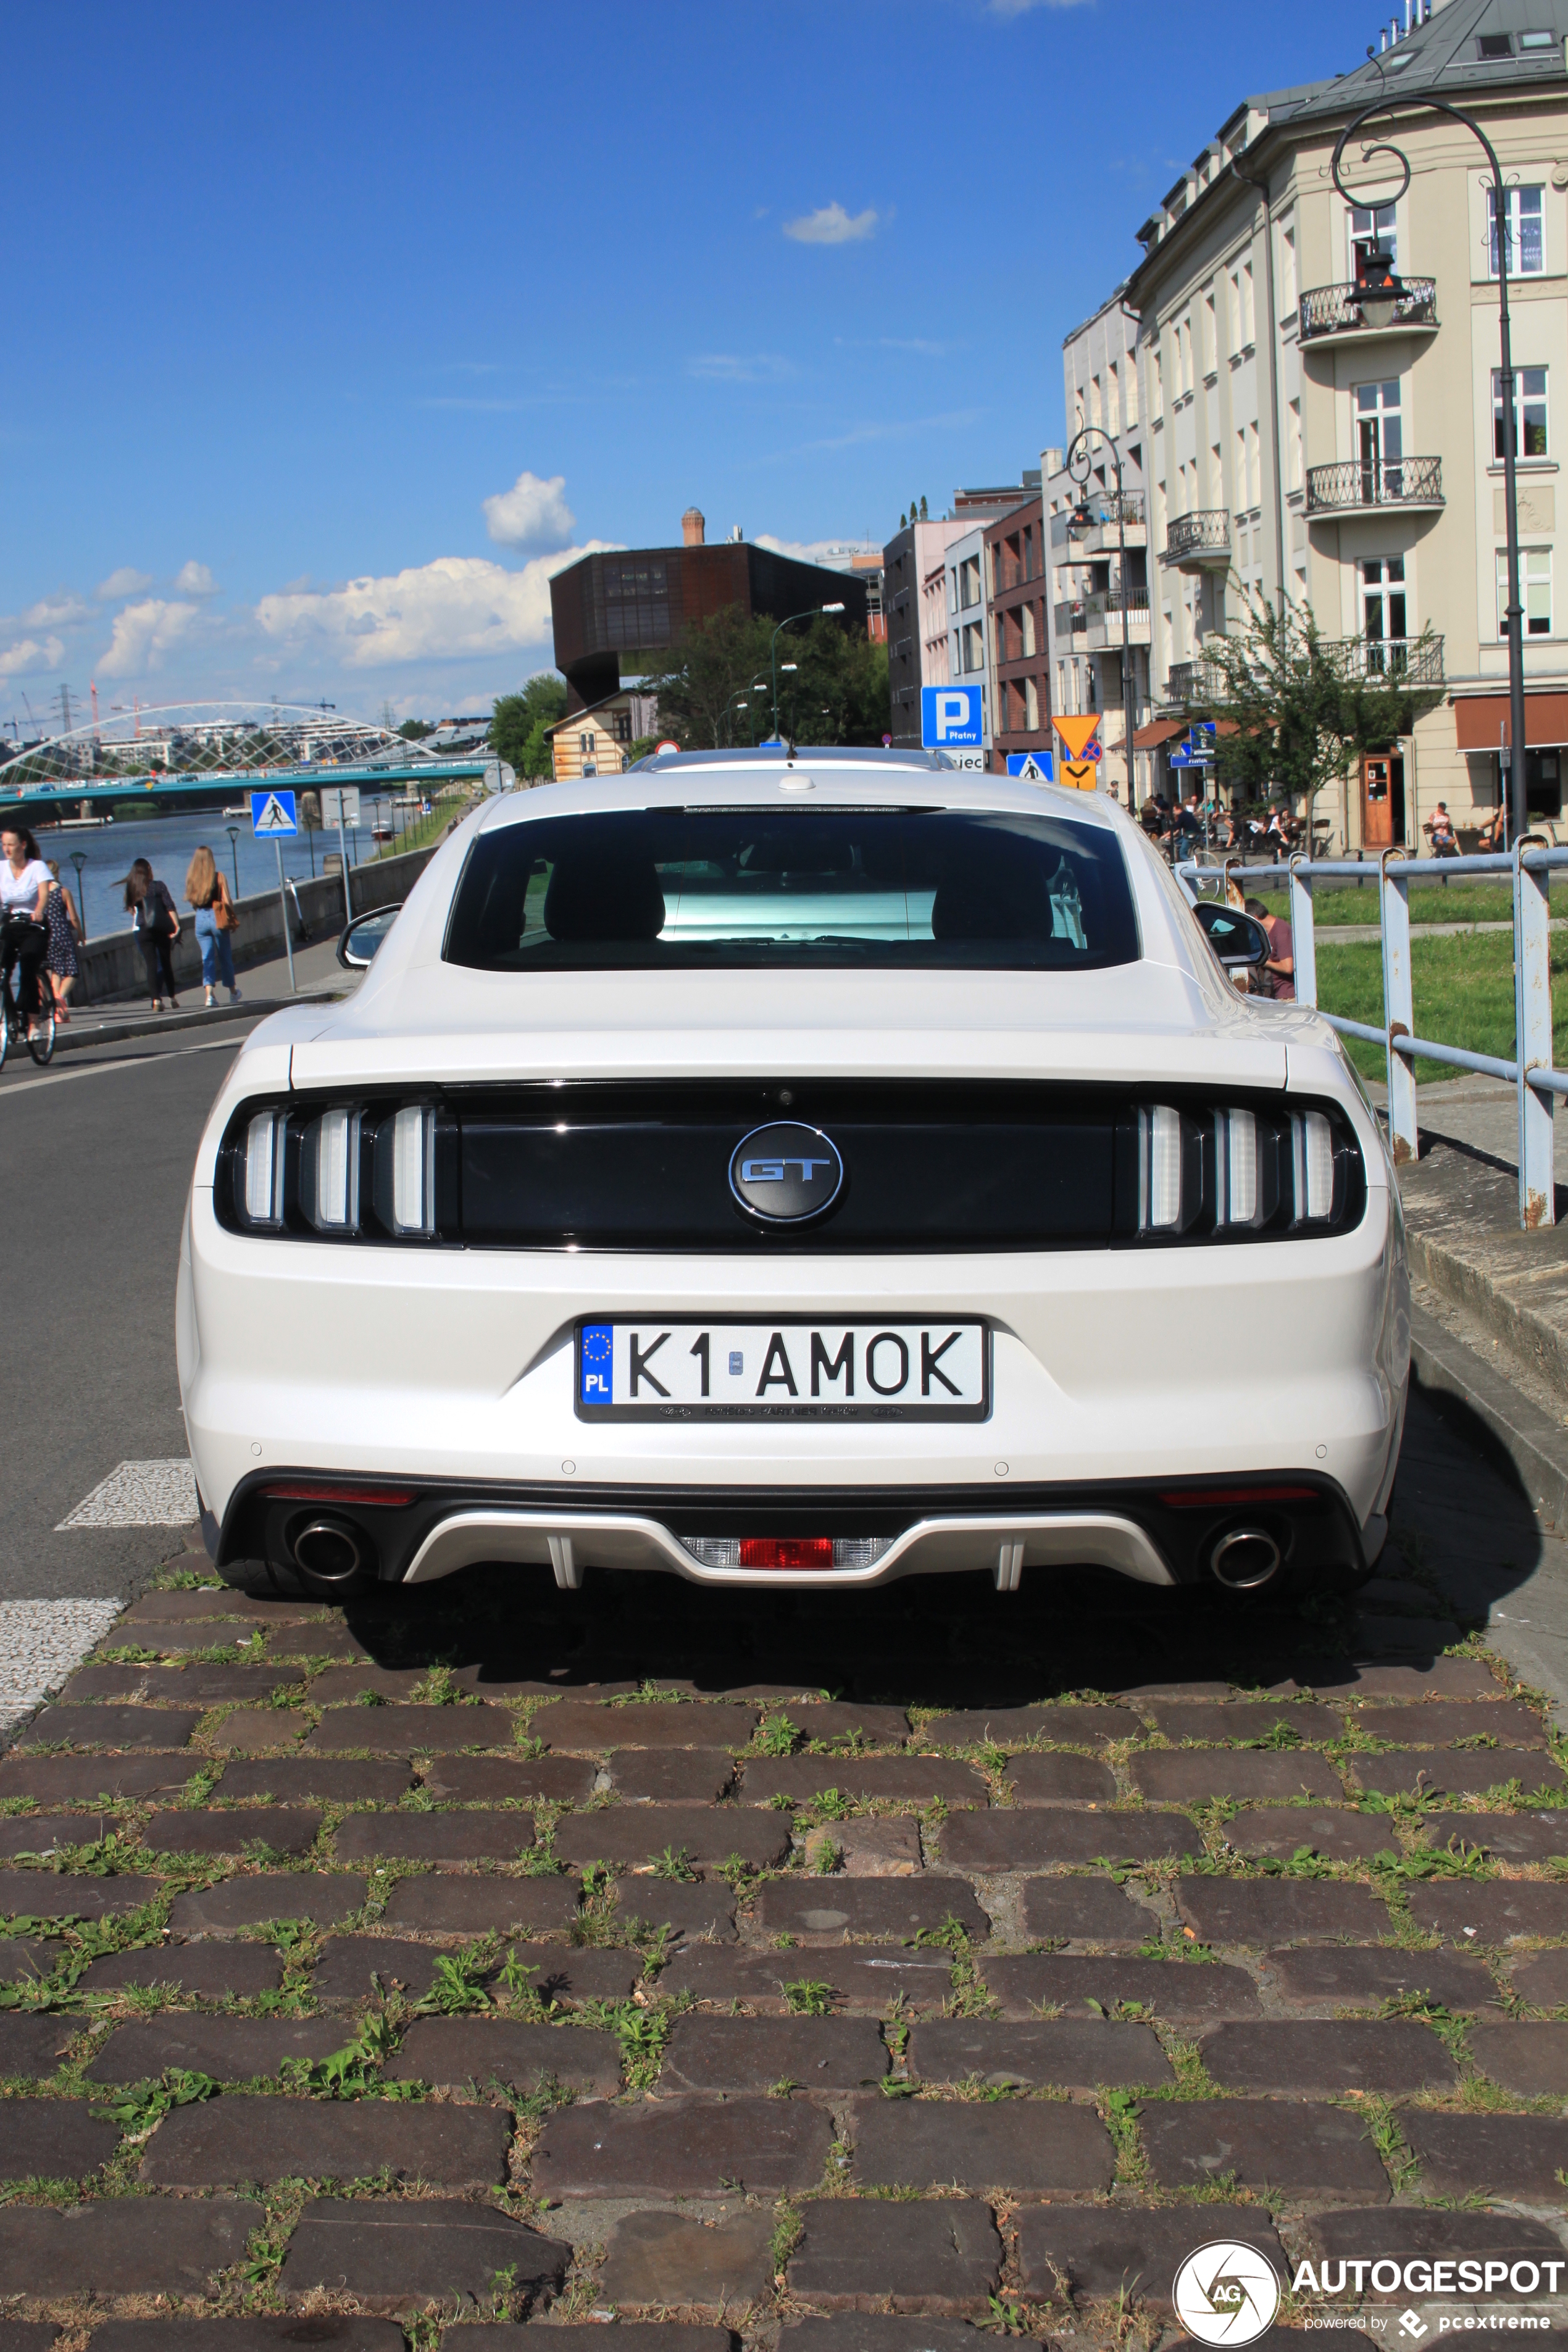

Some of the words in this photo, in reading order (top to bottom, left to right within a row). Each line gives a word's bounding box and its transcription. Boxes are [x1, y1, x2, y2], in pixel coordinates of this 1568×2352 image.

[936, 692, 969, 740] P
[949, 731, 976, 741] Płatny
[954, 754, 982, 769] iec
[742, 1159, 830, 1182] GT
[630, 1332, 709, 1396] K1
[756, 1332, 962, 1396] AMOK
[586, 1374, 609, 1392] PL
[704, 1407, 754, 1416] FordStore
[759, 1407, 817, 1416] PARTNER
